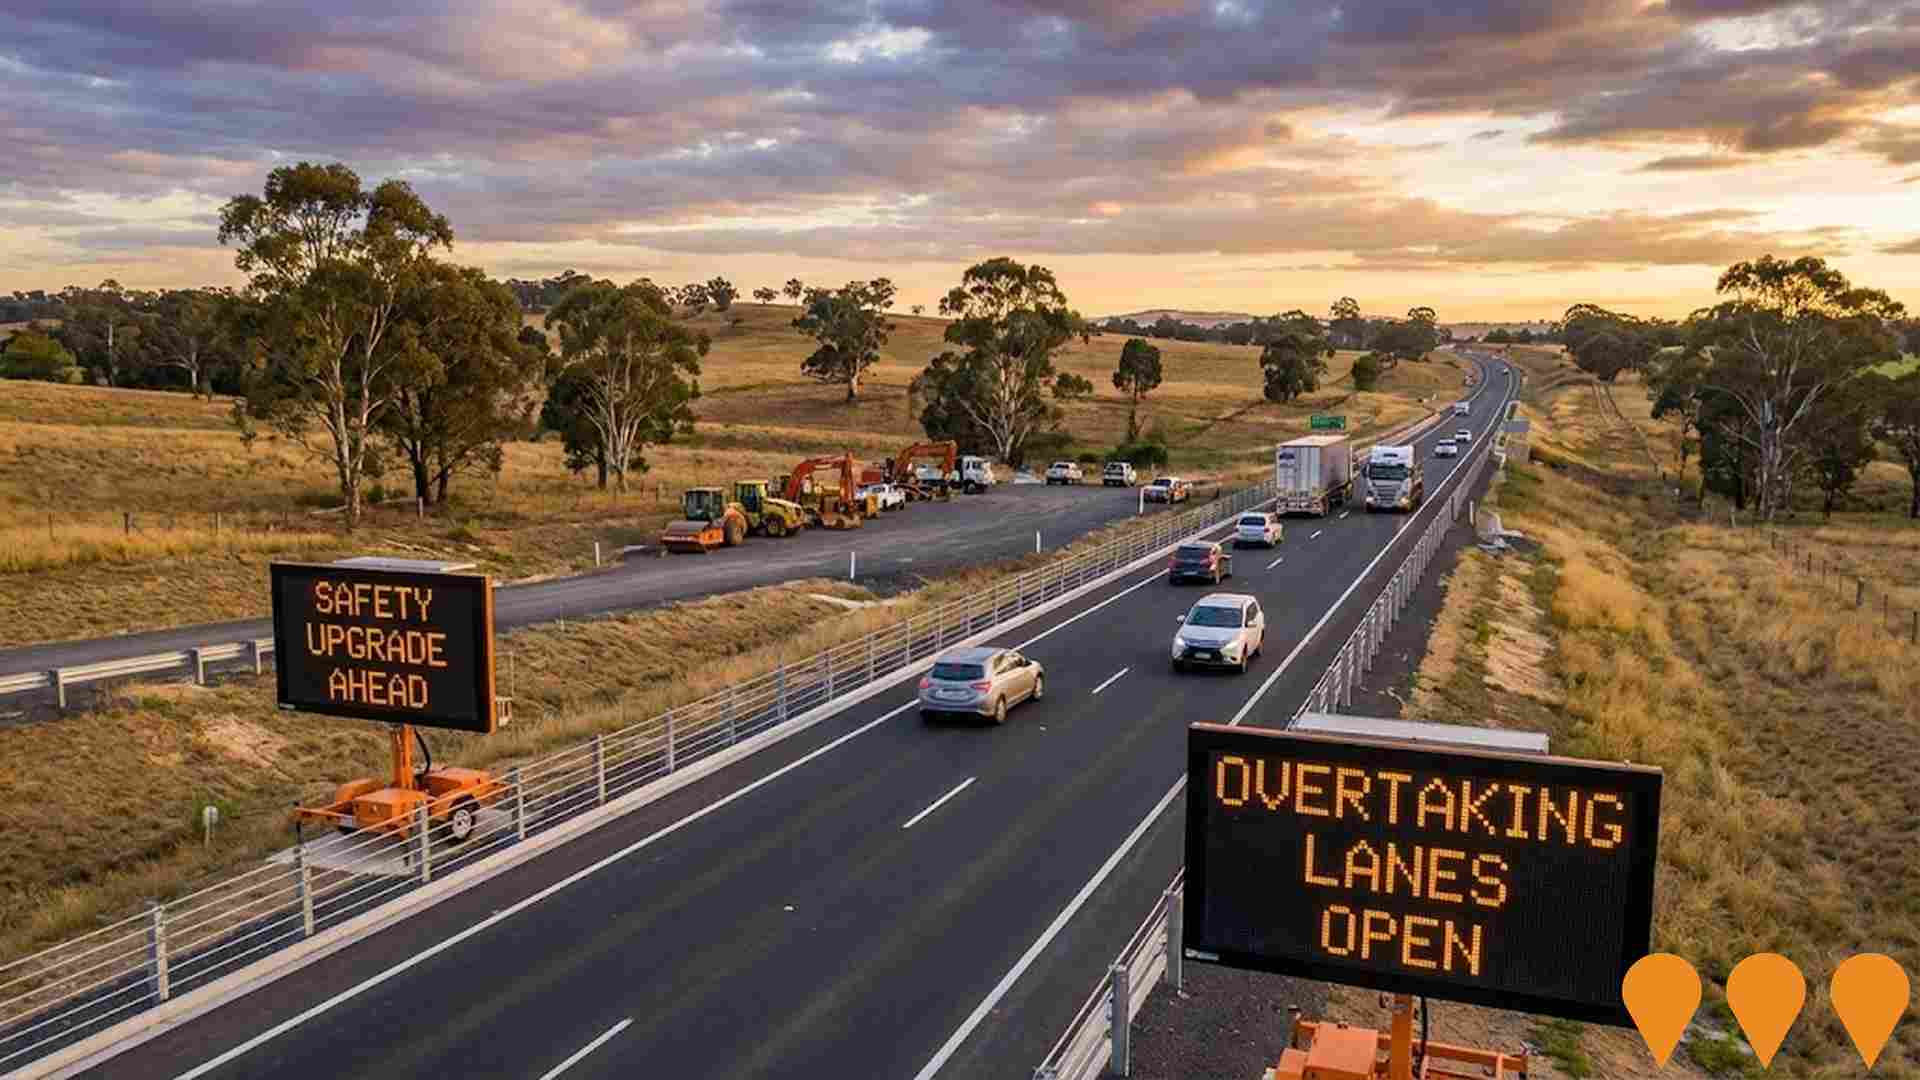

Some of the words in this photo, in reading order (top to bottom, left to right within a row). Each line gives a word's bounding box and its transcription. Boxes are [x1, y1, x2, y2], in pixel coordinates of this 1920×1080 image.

[315, 581, 432, 621] SAFETY
[307, 623, 447, 666] UPGRADE
[329, 668, 428, 708] AHEAD
[1215, 755, 1624, 849] OVERTAKING
[1304, 833, 1509, 908] LANES
[1320, 905, 1485, 977] OPEN
